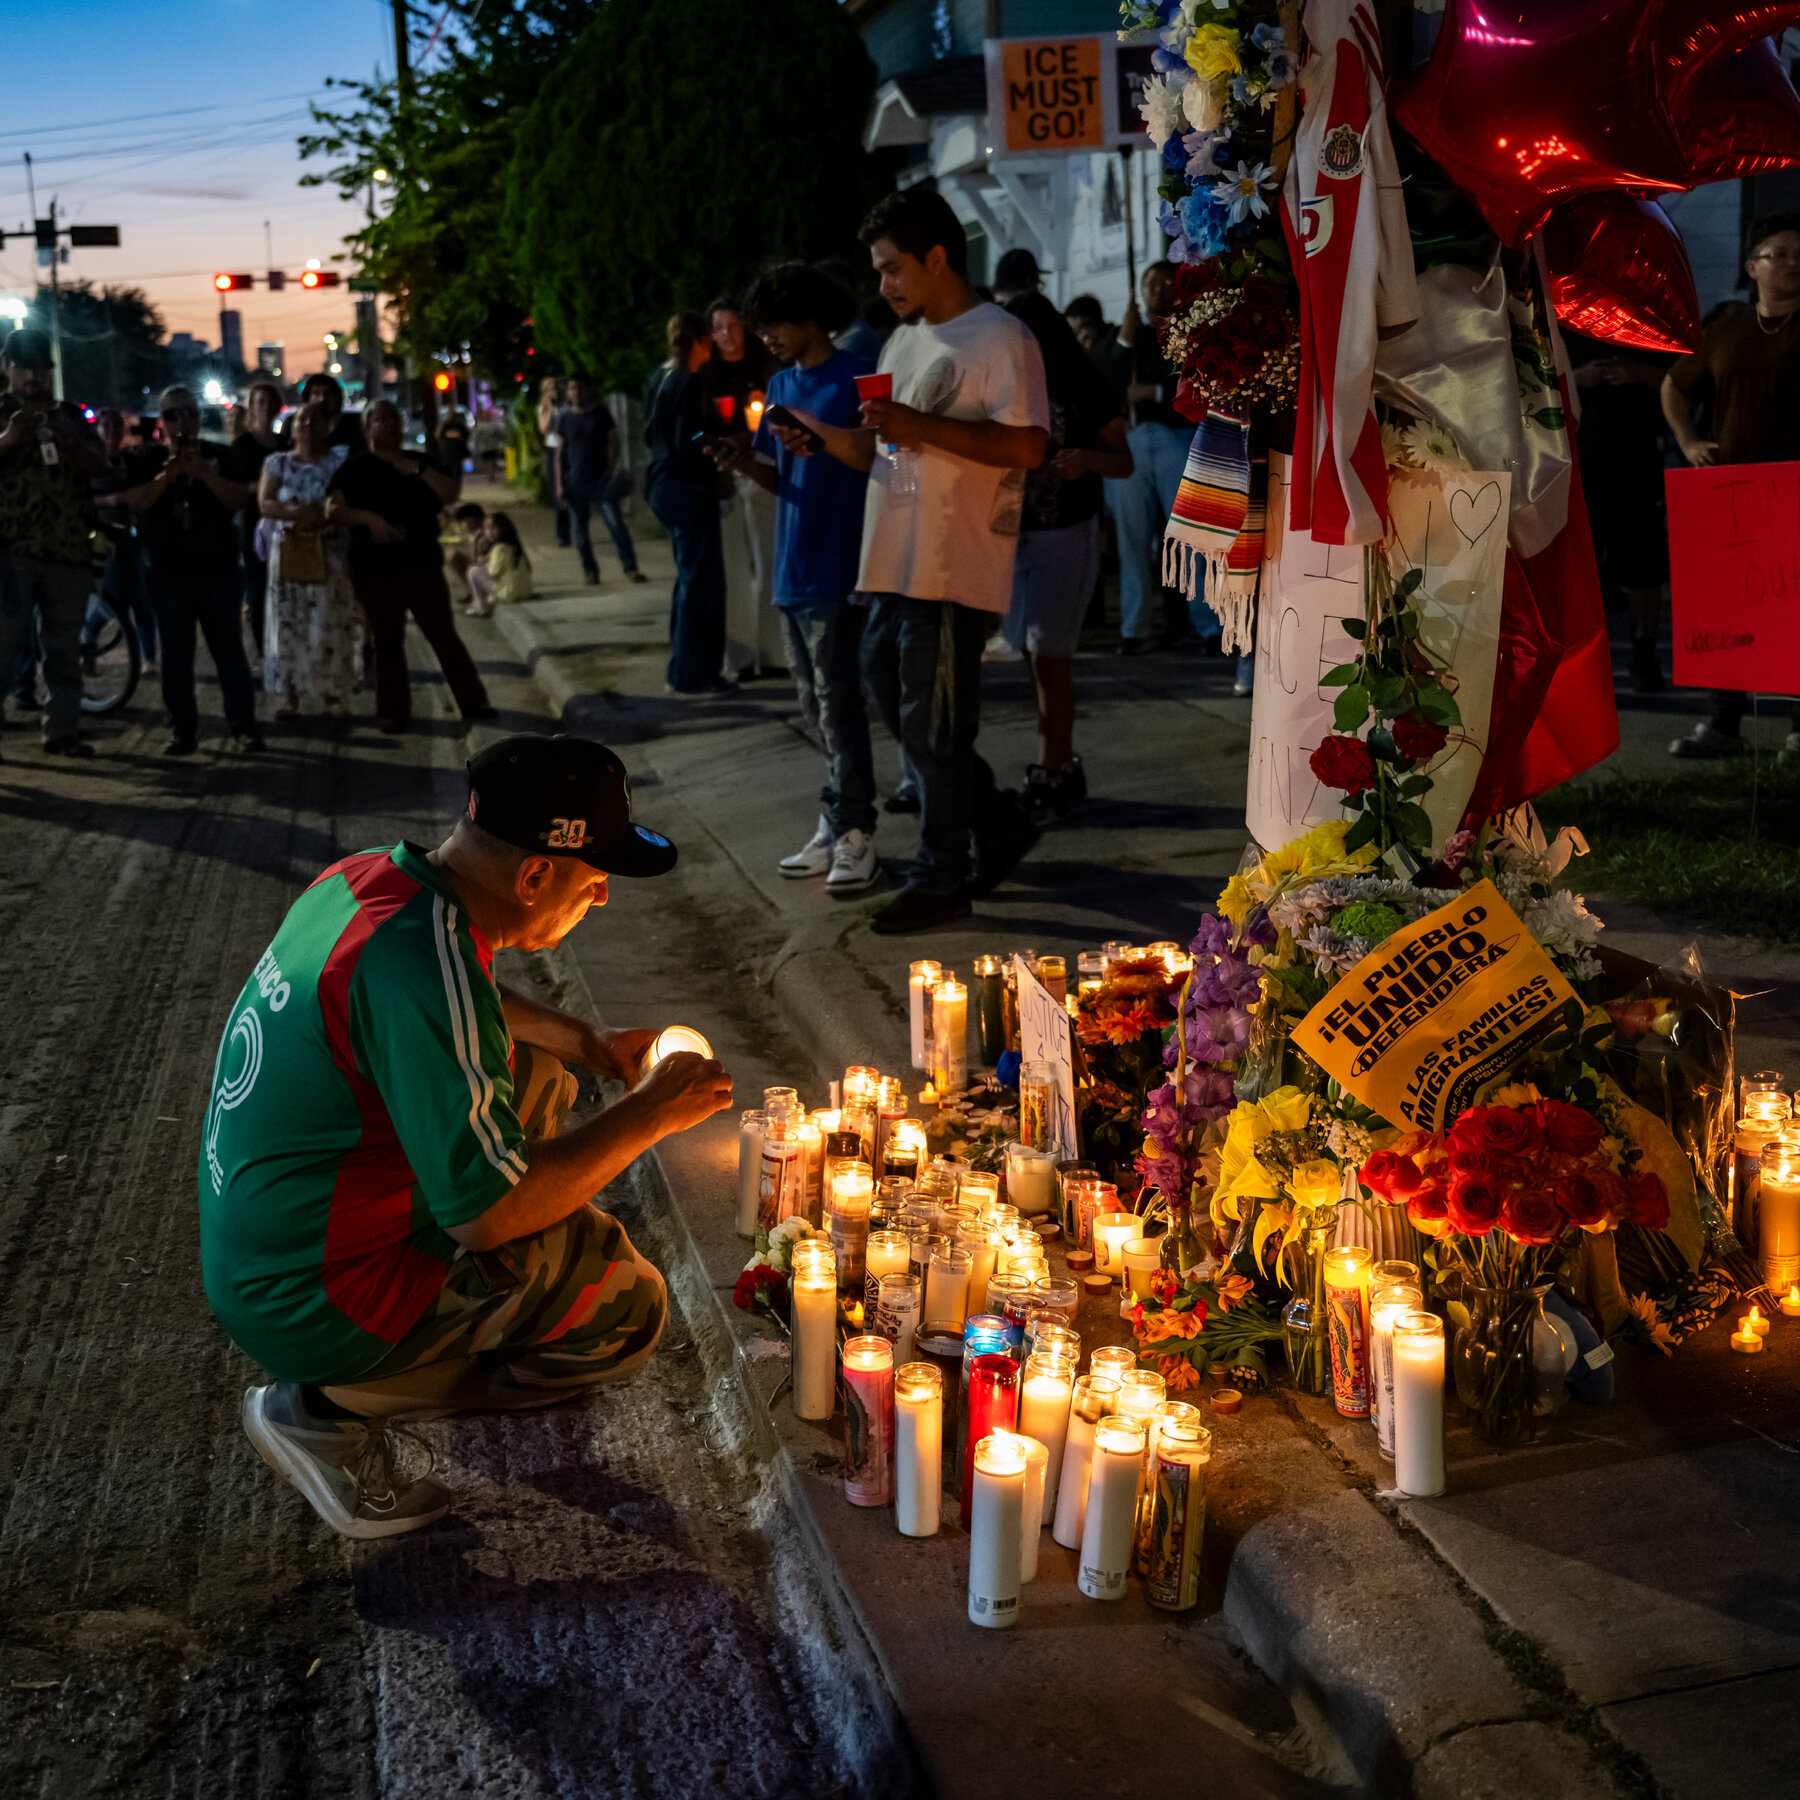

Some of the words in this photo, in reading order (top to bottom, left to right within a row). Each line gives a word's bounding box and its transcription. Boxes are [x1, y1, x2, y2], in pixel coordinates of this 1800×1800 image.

[1025, 45, 1078, 77] ICE
[1009, 77, 1098, 111] MUST
[1027, 109, 1085, 142] GO!
[253, 945, 291, 1012] EXICO
[1318, 999, 1365, 1043] ¡EL
[1362, 906, 1487, 994] PUEBLO
[1342, 931, 1487, 1047] UNIDO
[1356, 943, 1509, 1072] DEFENDERÁ
[1441, 975, 1549, 1048] FAMILIAS
[1406, 1051, 1440, 1097] LAS
[1415, 987, 1557, 1133] MIGRANTES!
[1454, 1056, 1502, 1097] Socialism
[1399, 1100, 1415, 1121] A
